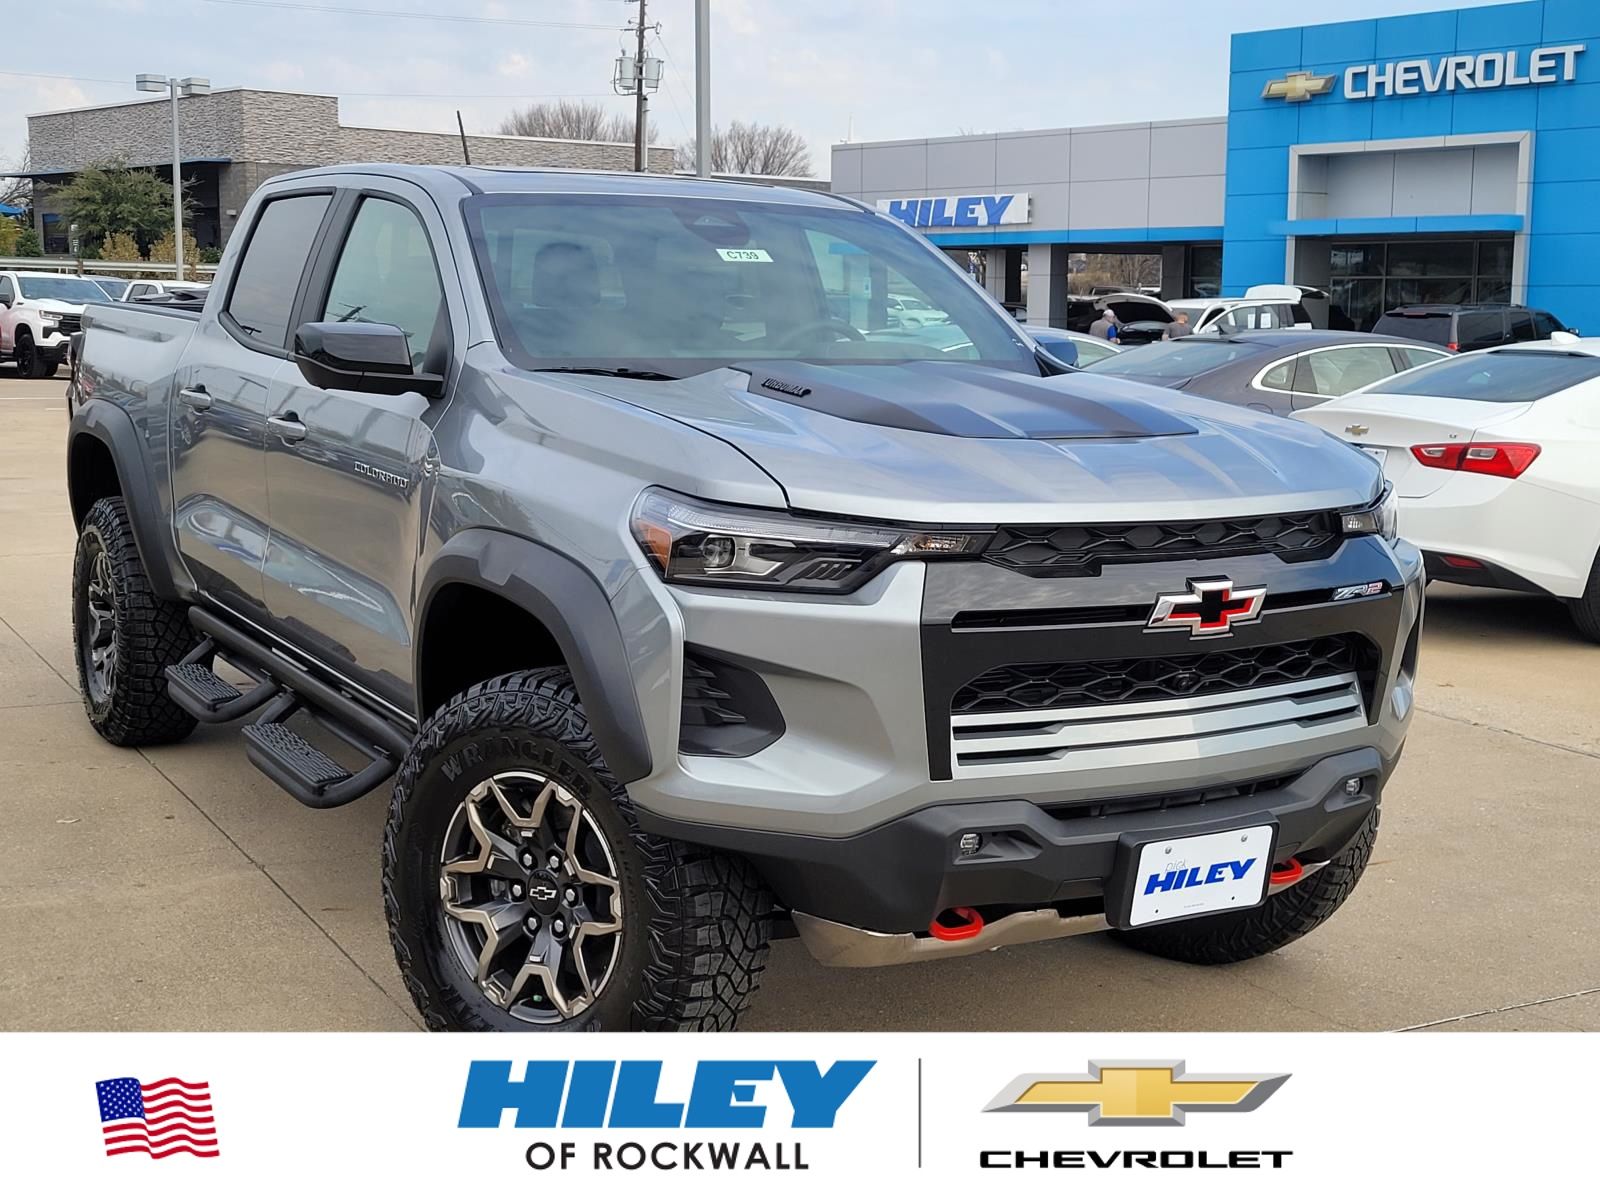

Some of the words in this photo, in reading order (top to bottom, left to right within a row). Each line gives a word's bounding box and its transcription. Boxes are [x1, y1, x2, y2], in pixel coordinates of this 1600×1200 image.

[1344, 44, 1585, 99] CHEVROLET
[888, 195, 1015, 227] HILEY
[726, 251, 759, 260] C739
[354, 461, 410, 488] COLORADO
[1333, 581, 1384, 600] ZR2
[440, 735, 594, 799] WRANGLER
[1143, 857, 1257, 896] HILEY
